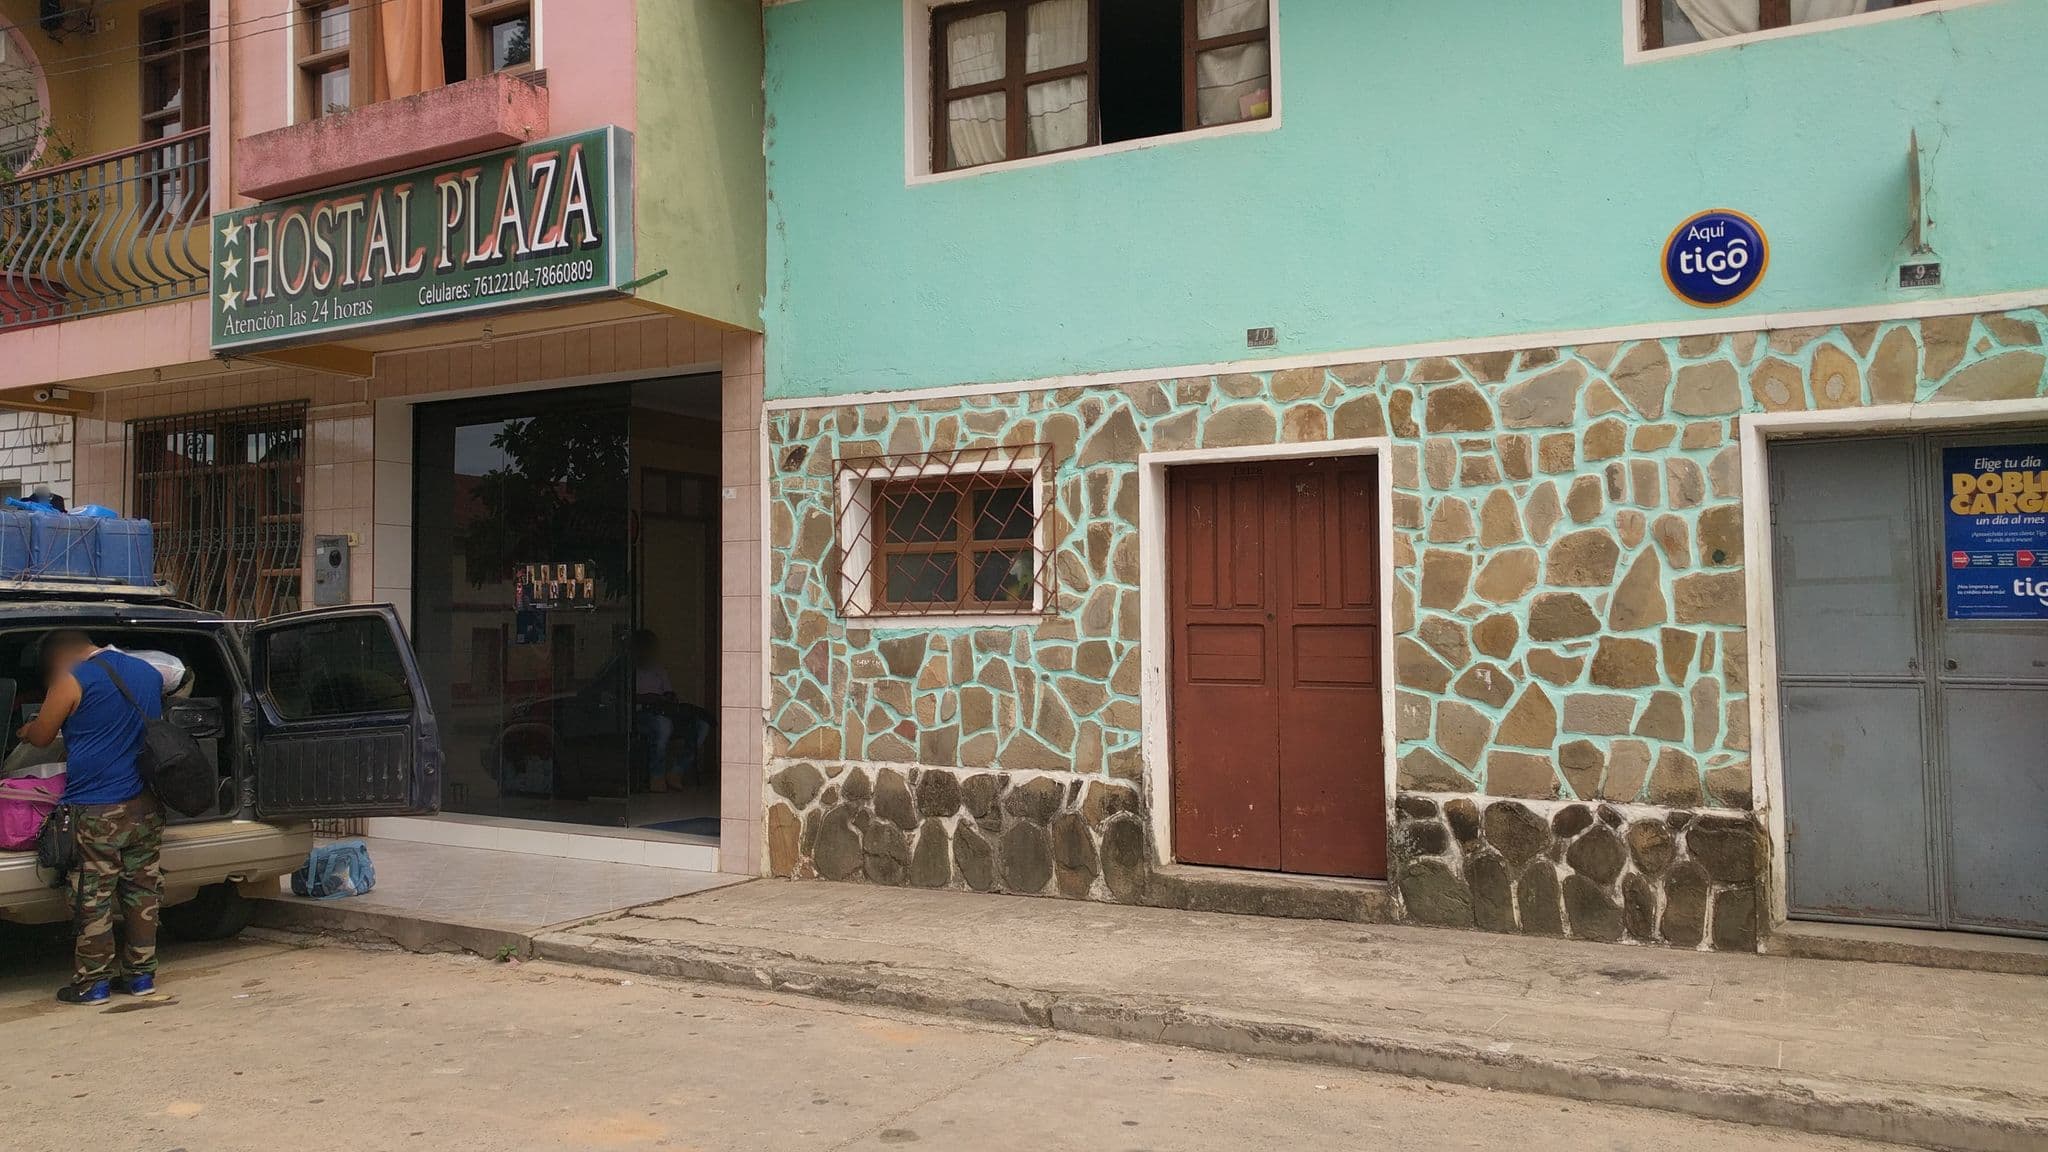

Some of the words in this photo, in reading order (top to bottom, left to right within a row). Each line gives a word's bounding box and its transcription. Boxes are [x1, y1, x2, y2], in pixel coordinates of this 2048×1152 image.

[244, 187, 423, 301] HOSTAL
[436, 148, 599, 269] PLAZA
[1687, 221, 1725, 243] Aquí
[1679, 238, 1749, 276] tigo
[418, 282, 471, 305] Celulares:
[474, 259, 594, 297] 76122104-78660809
[1915, 265, 1926, 280] 9
[223, 311, 285, 337] Atención
[289, 304, 307, 327] las
[311, 298, 329, 323] 24
[333, 297, 373, 321] horas
[1974, 458, 2002, 472] Elige
[2004, 458, 2018, 469] tu
[2020, 456, 2042, 468] día
[1975, 518, 1990, 526] un
[1991, 515, 2009, 526] día
[2010, 514, 2022, 525] al
[2023, 516, 2046, 524] mes
